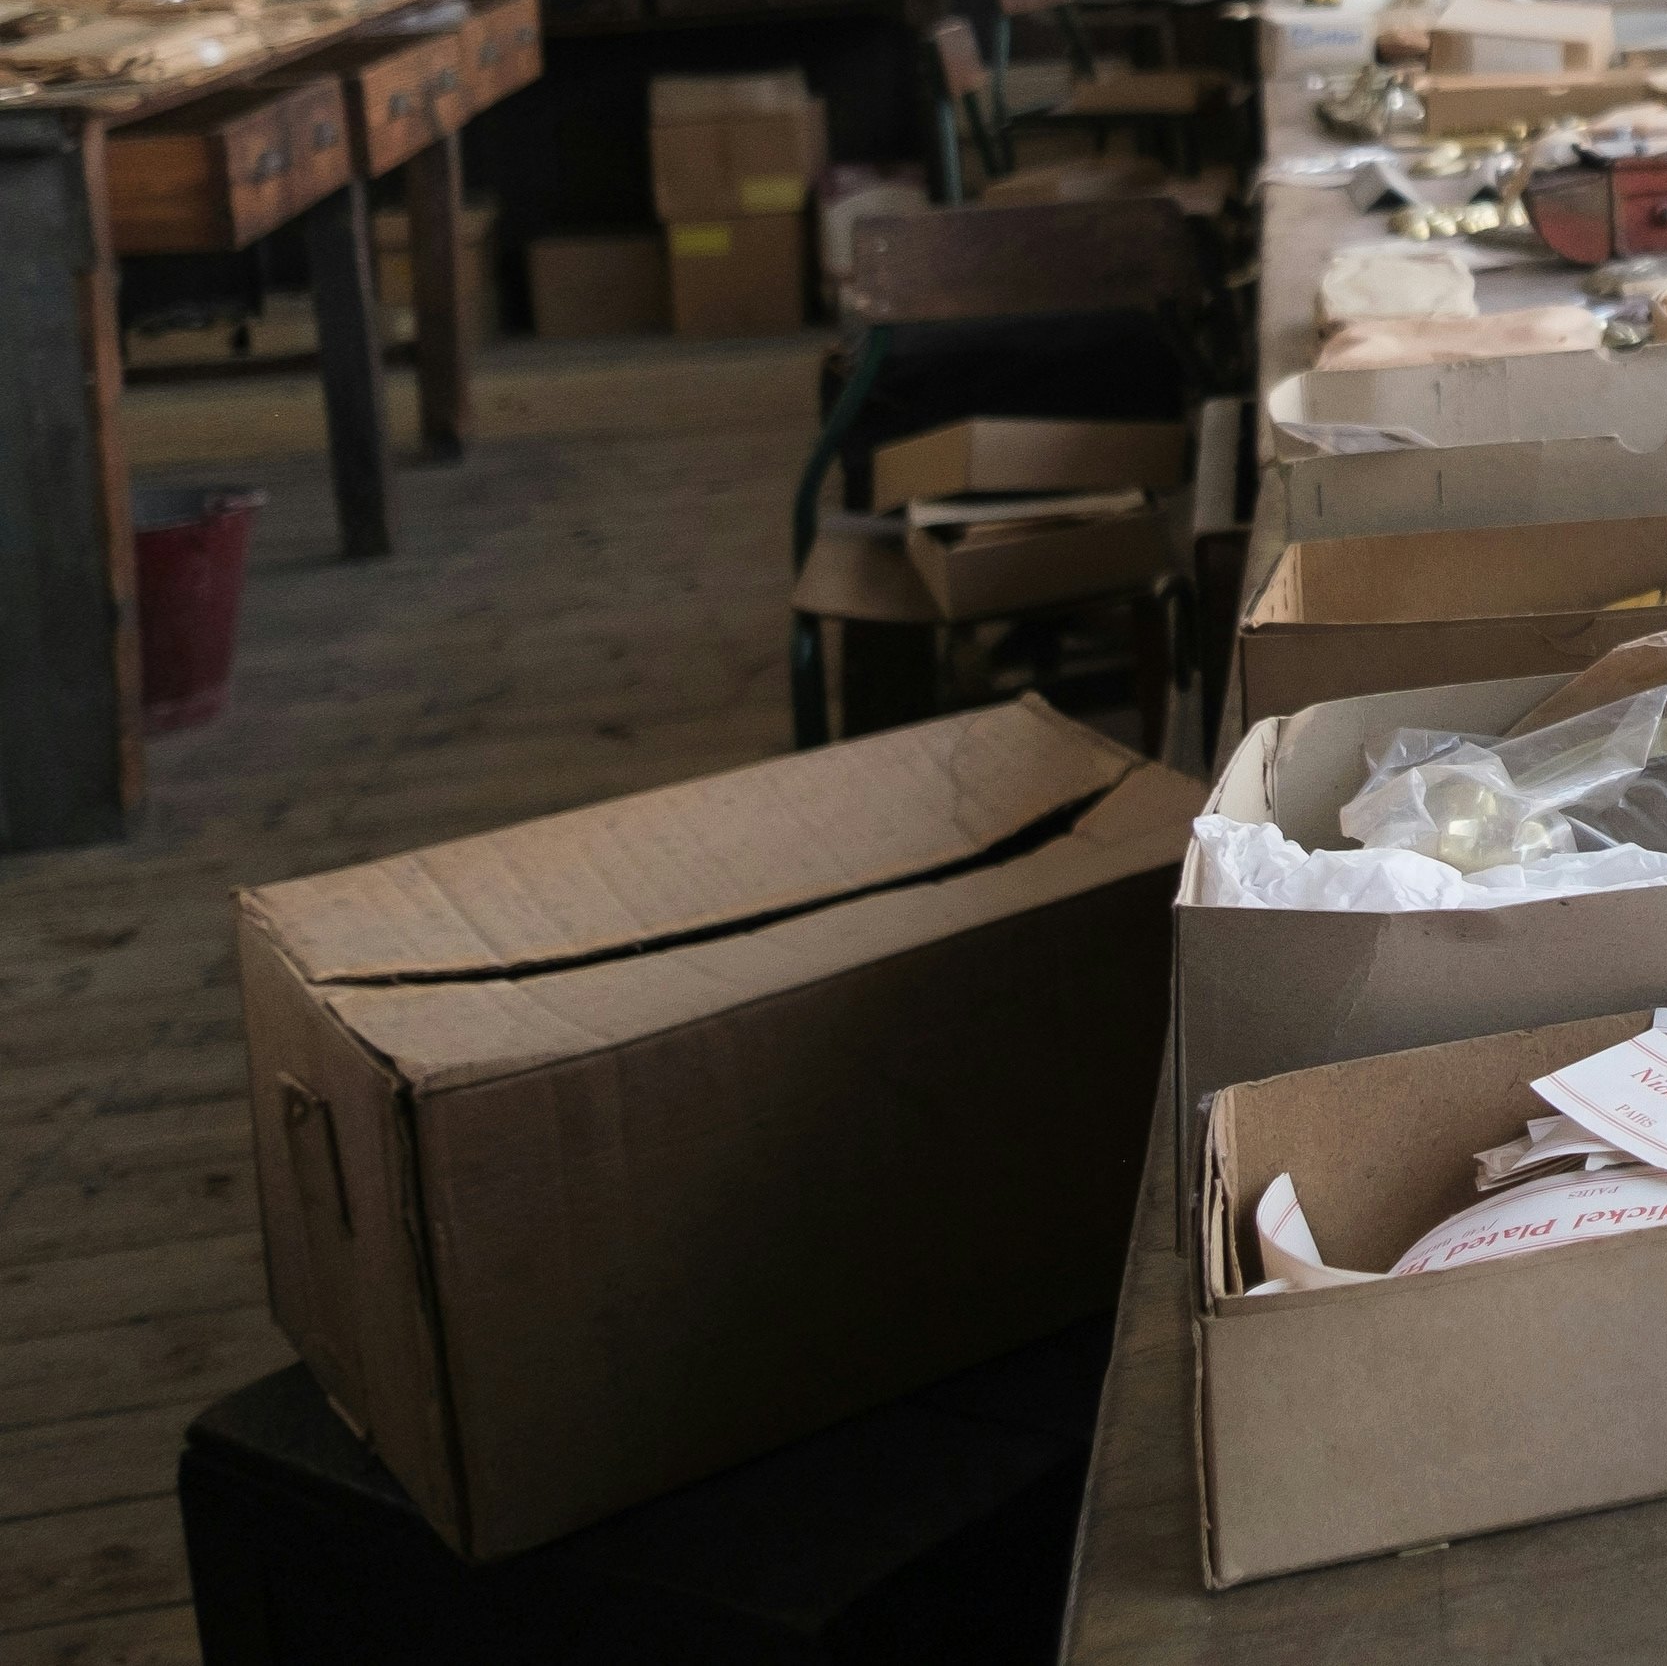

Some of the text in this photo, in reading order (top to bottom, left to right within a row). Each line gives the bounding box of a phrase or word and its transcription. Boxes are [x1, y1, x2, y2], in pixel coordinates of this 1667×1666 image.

[1615, 1103, 1658, 1129] PAIRS
[1567, 1185, 1620, 1201] PAIRS
[1442, 1218, 1558, 1262] Plated
